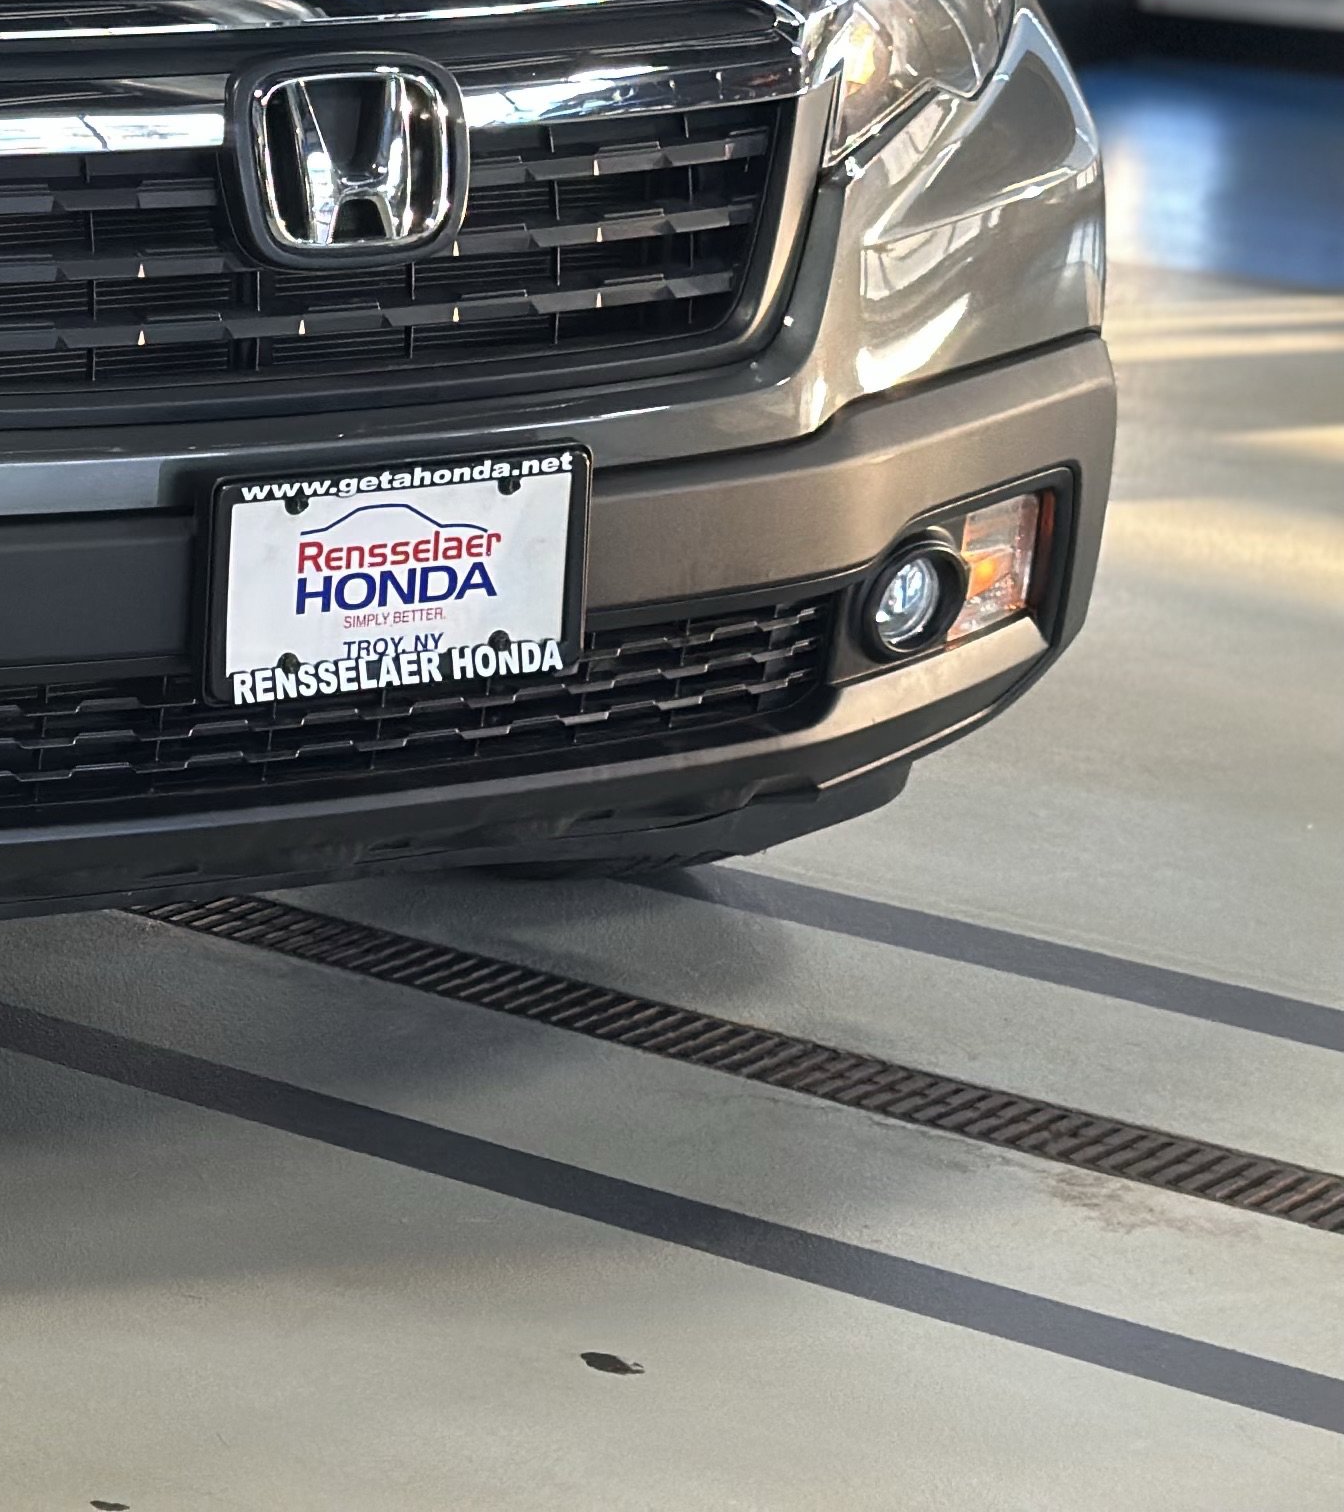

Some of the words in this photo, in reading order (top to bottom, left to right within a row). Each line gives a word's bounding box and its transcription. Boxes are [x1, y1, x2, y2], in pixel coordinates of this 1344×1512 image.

[241, 451, 574, 501] www.getahonda.net
[296, 531, 502, 574] Rensselaer
[295, 561, 498, 615] HONDA
[343, 612, 390, 629] SIMPLY
[414, 632, 444, 652] NY
[233, 650, 444, 705] RENSSELAER
[451, 639, 564, 680] HONDA
